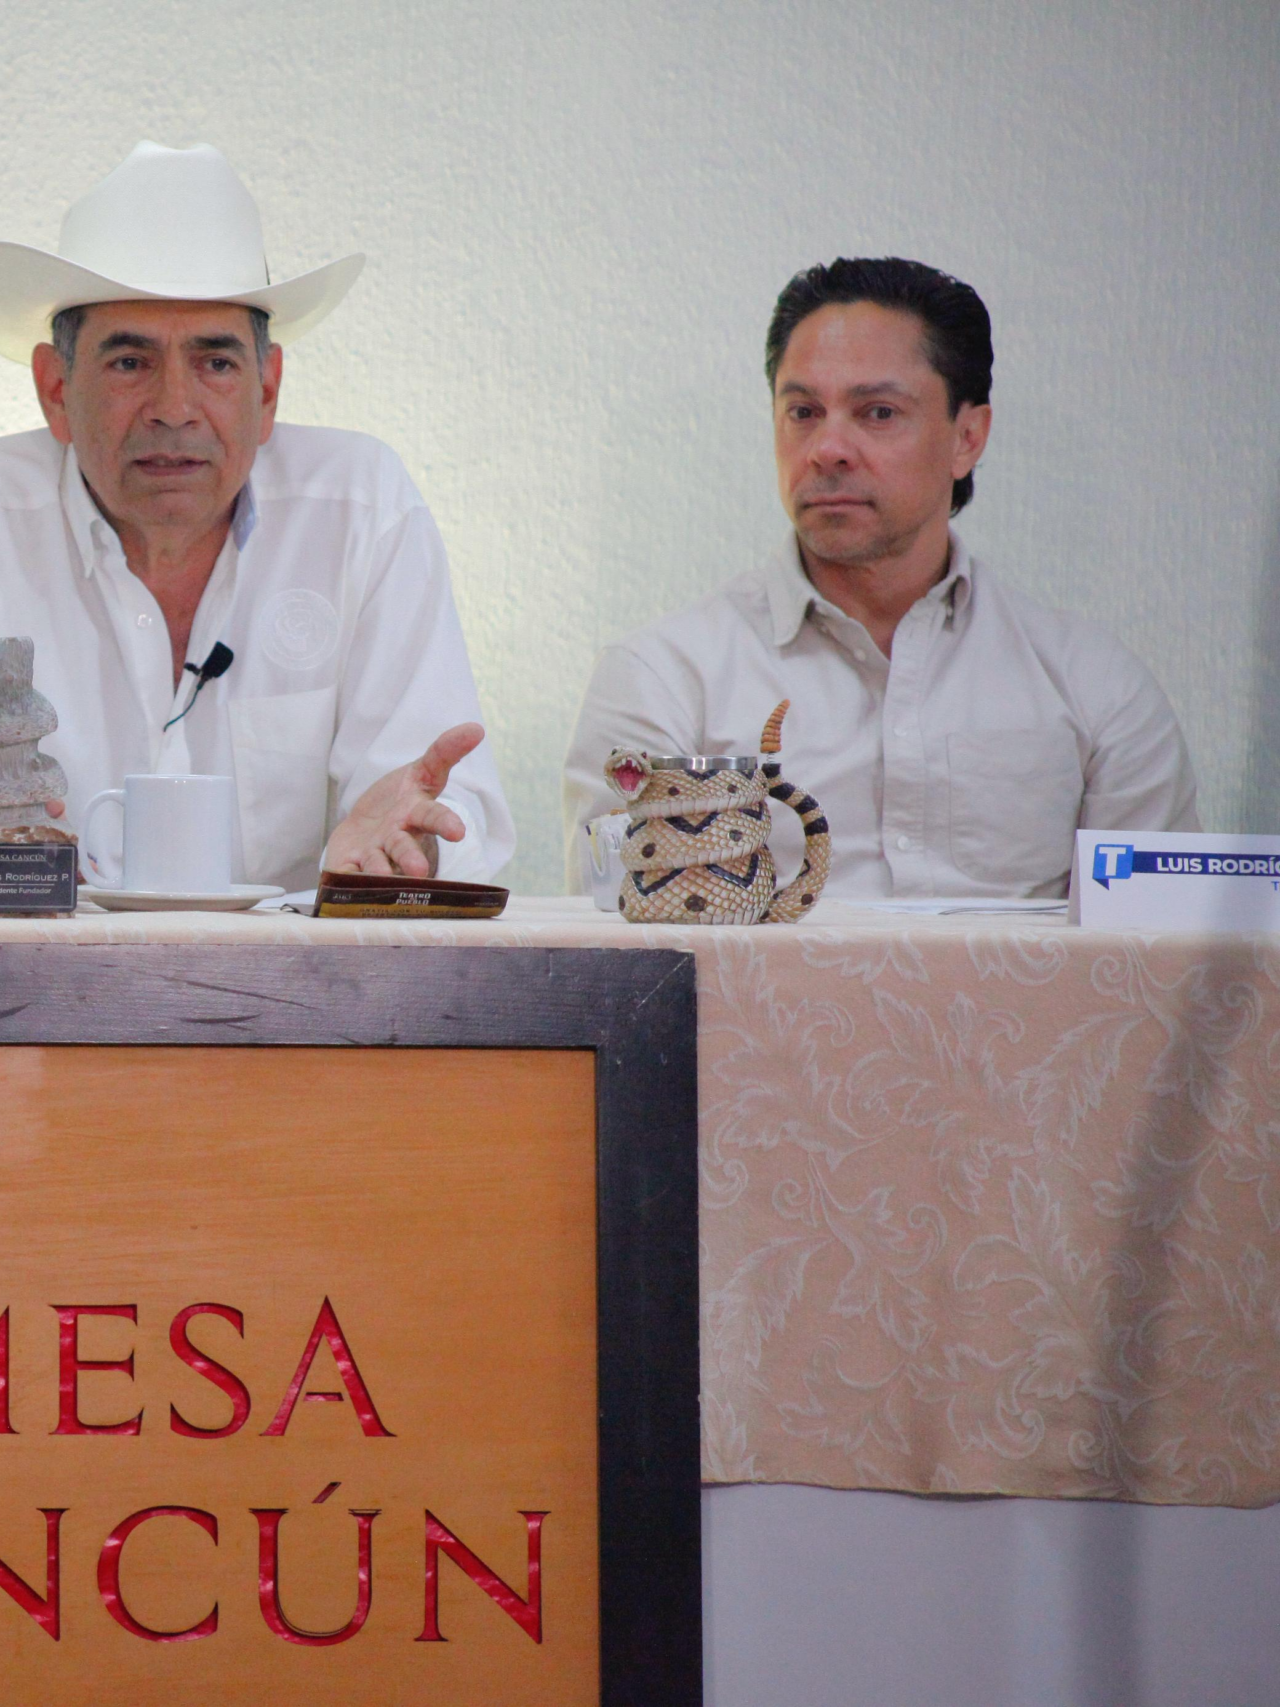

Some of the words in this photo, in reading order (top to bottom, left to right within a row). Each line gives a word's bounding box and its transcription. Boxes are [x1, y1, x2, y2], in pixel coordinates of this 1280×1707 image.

[12, 853, 47, 861] CANCÚN
[1156, 857, 1203, 873] LUIS
[5, 871, 58, 882] RODRÍGUEZ
